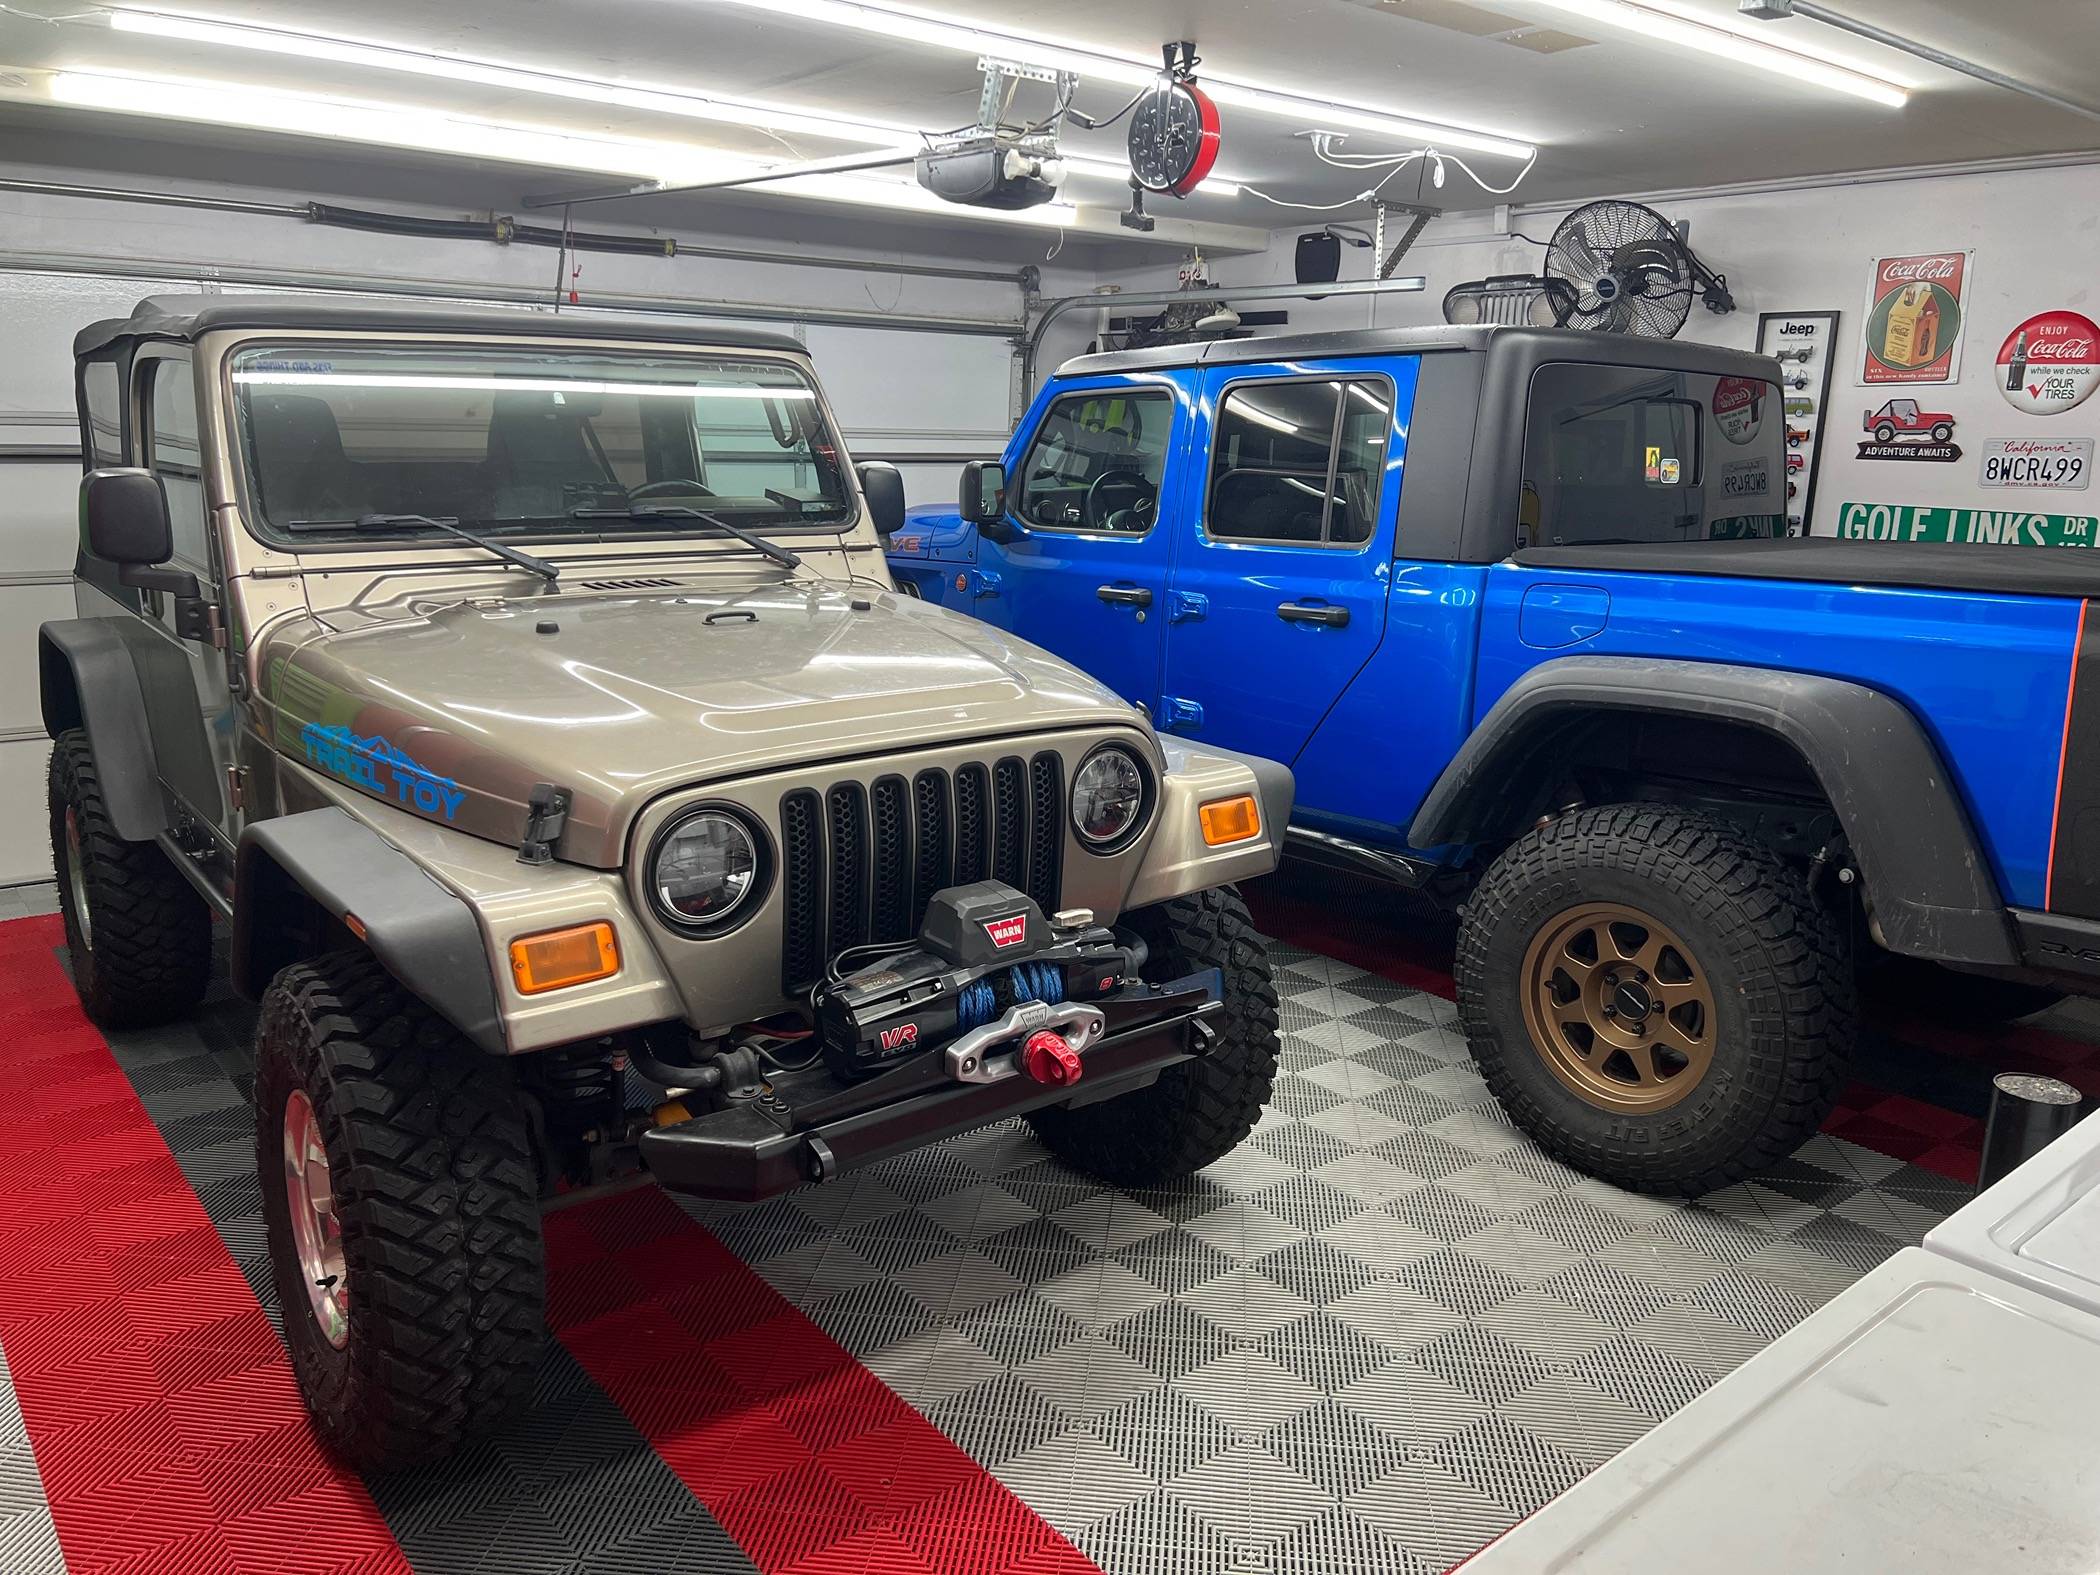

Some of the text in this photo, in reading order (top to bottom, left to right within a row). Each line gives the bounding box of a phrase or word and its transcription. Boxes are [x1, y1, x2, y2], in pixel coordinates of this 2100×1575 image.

[1882, 257, 1958, 281] Coca-Cola
[1780, 322, 1815, 336] Jeep
[2040, 326, 2068, 335] ENJOY
[2027, 339, 2094, 359] Coca-Cola
[2046, 378, 2074, 388] YOUR
[2045, 389, 2075, 399] TIRES
[1865, 447, 1951, 457] ADVENTURE AWAITS
[2004, 440, 2071, 456] California
[1986, 457, 2083, 481] 8WCR499
[1844, 504, 2088, 546] GOLF LINKS DR
[303, 730, 466, 821] TRAIL TOY
[1512, 878, 1582, 926] KENDA
[992, 924, 1022, 940] WARN
[880, 1022, 918, 1050] VR
[1656, 1068, 1733, 1140] KLEVER
